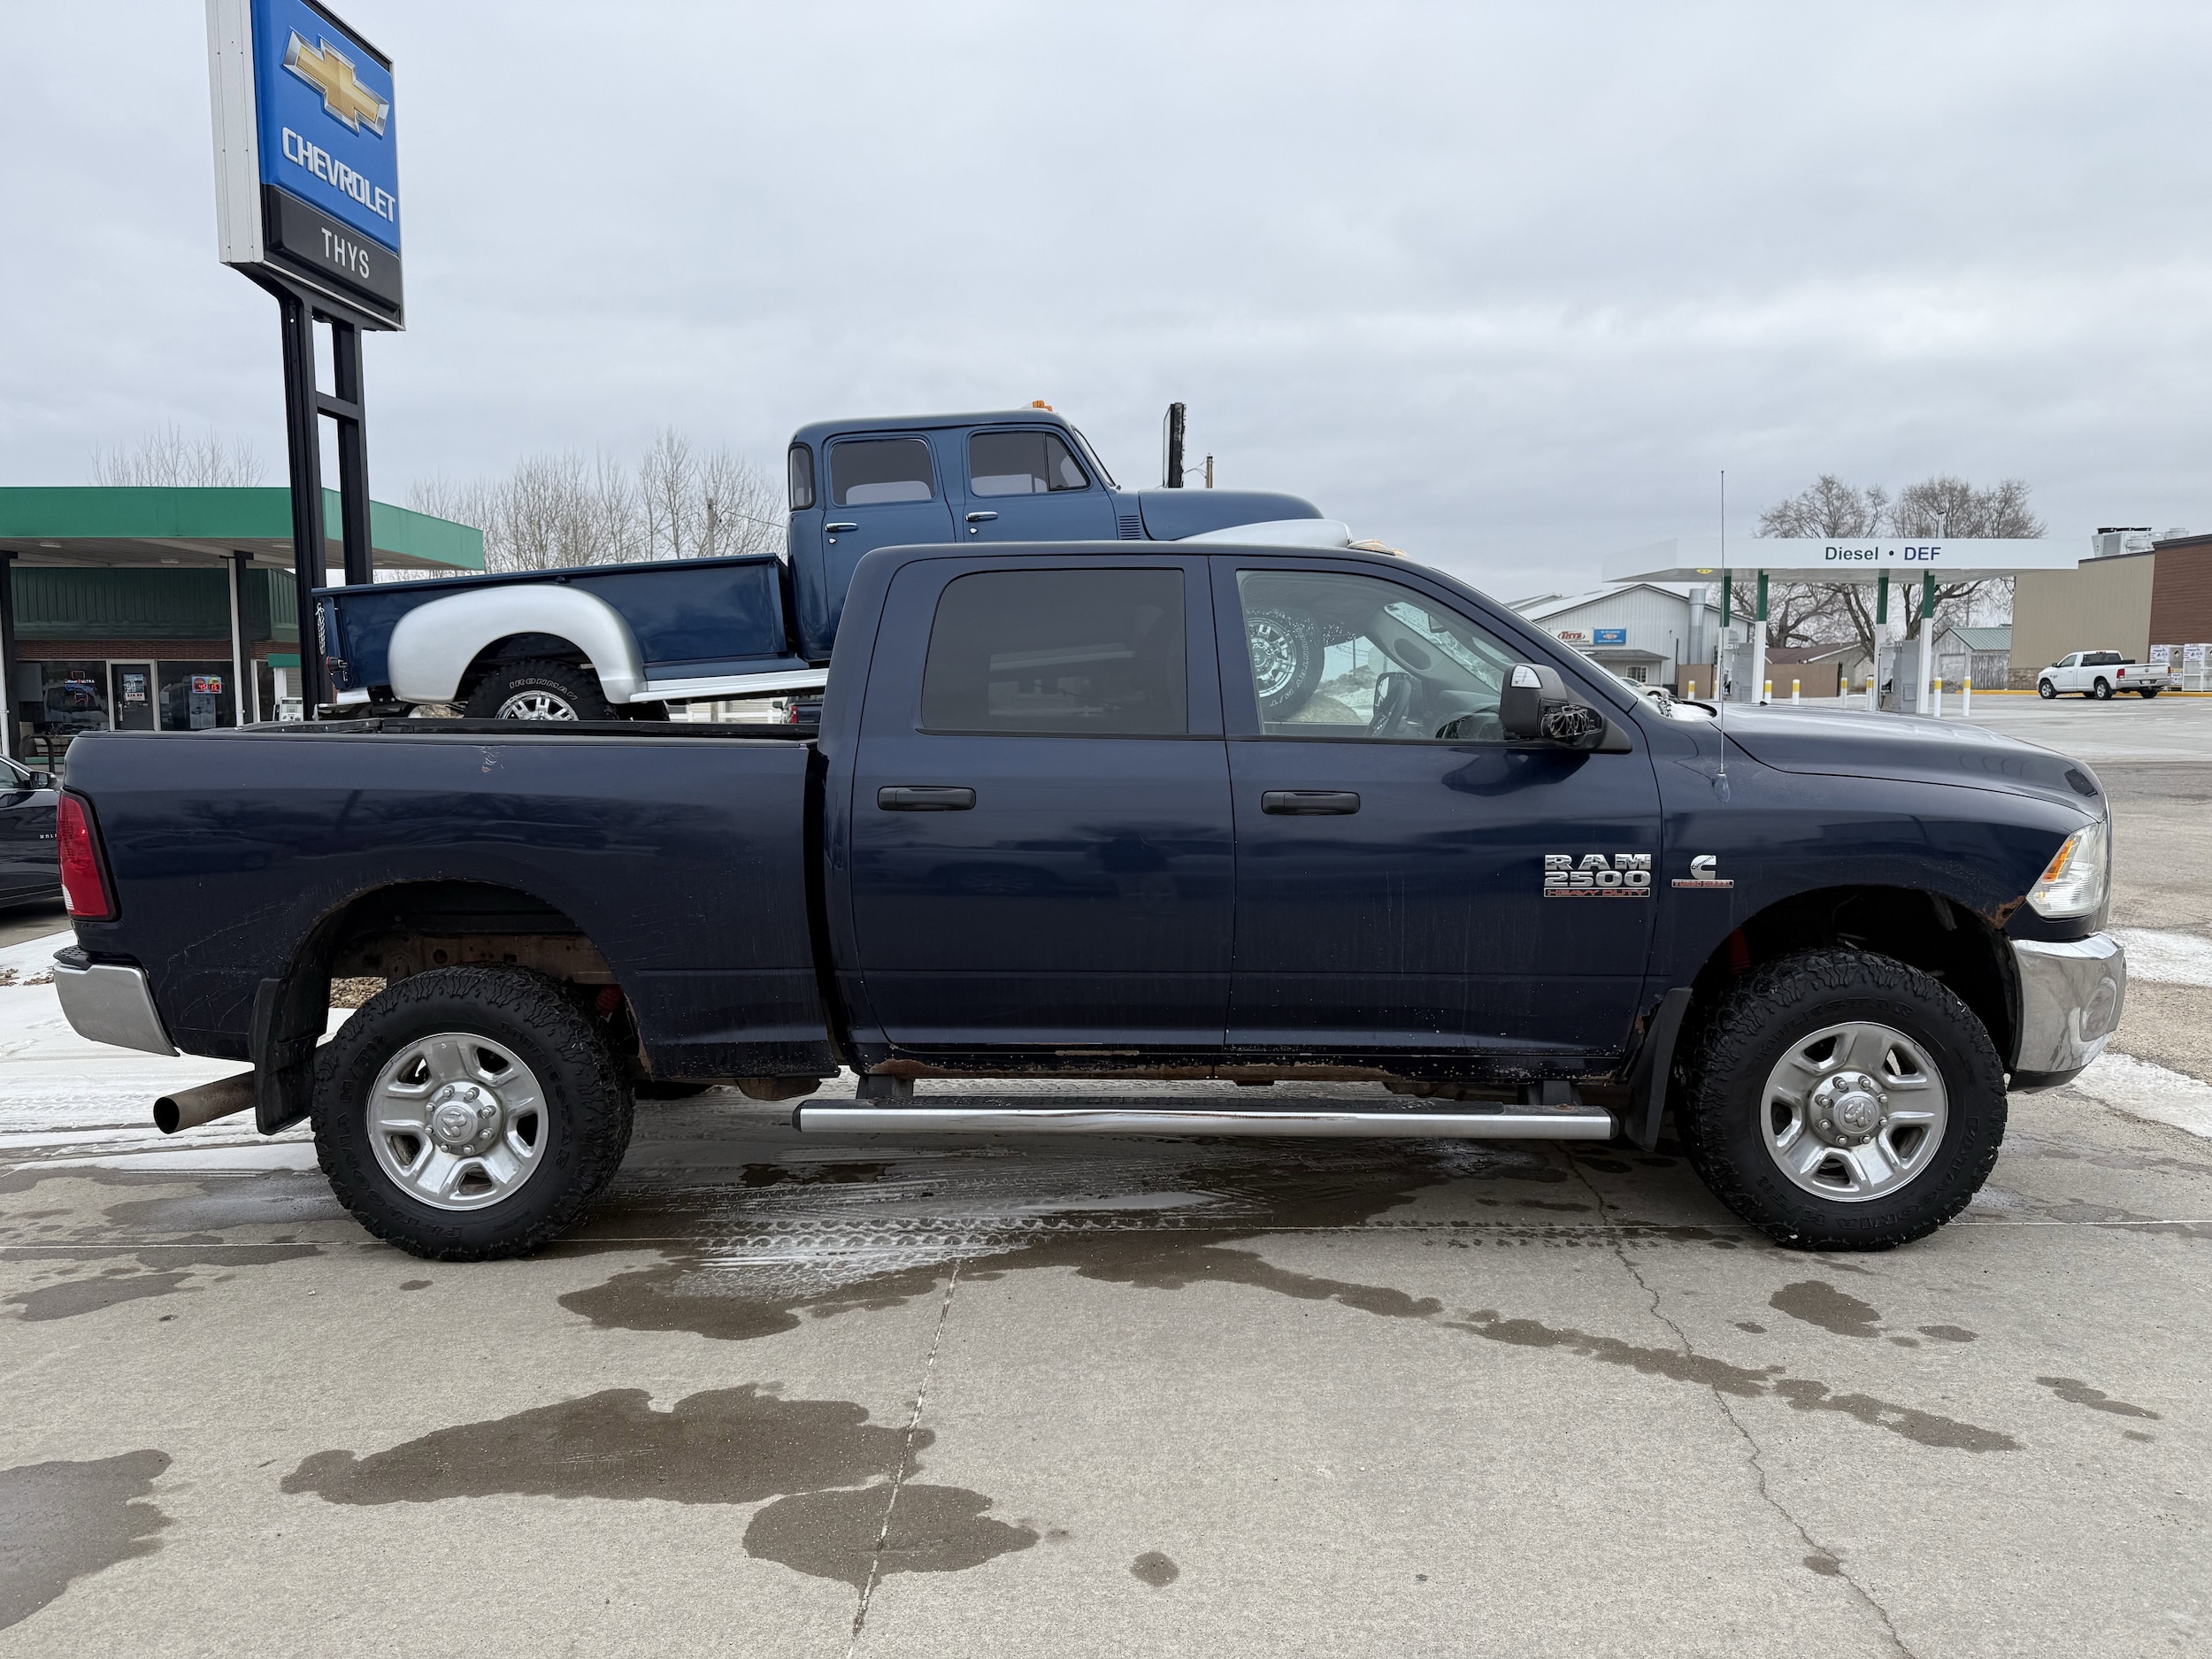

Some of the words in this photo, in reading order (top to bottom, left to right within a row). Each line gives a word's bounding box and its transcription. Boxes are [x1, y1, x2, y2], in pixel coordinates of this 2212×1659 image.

[281, 127, 396, 224] CHEVROLET
[321, 227, 371, 280] THYS
[1825, 546, 1878, 560] Diesel
[1904, 547, 1941, 561] DEF
[509, 677, 579, 701] IRONMAN
[1544, 853, 1652, 871] RAM
[1543, 870, 1651, 887] 2500
